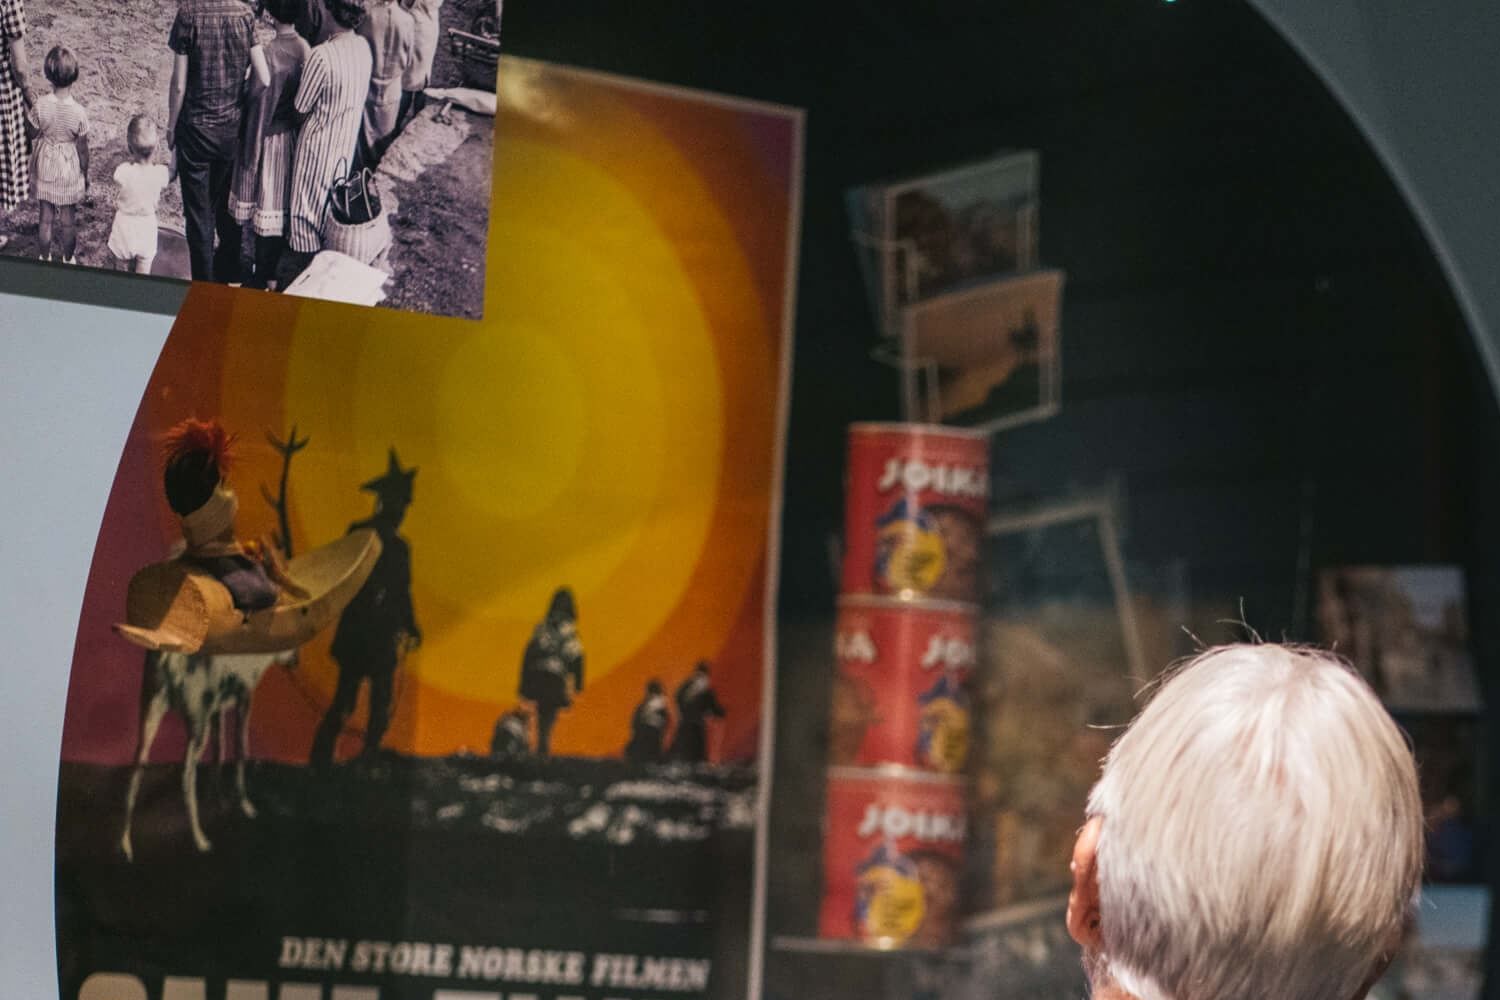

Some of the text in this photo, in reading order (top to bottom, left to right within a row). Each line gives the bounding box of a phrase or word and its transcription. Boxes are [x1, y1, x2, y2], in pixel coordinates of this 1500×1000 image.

[279, 936, 711, 991] DEN STORE NORSKE FILMEN
